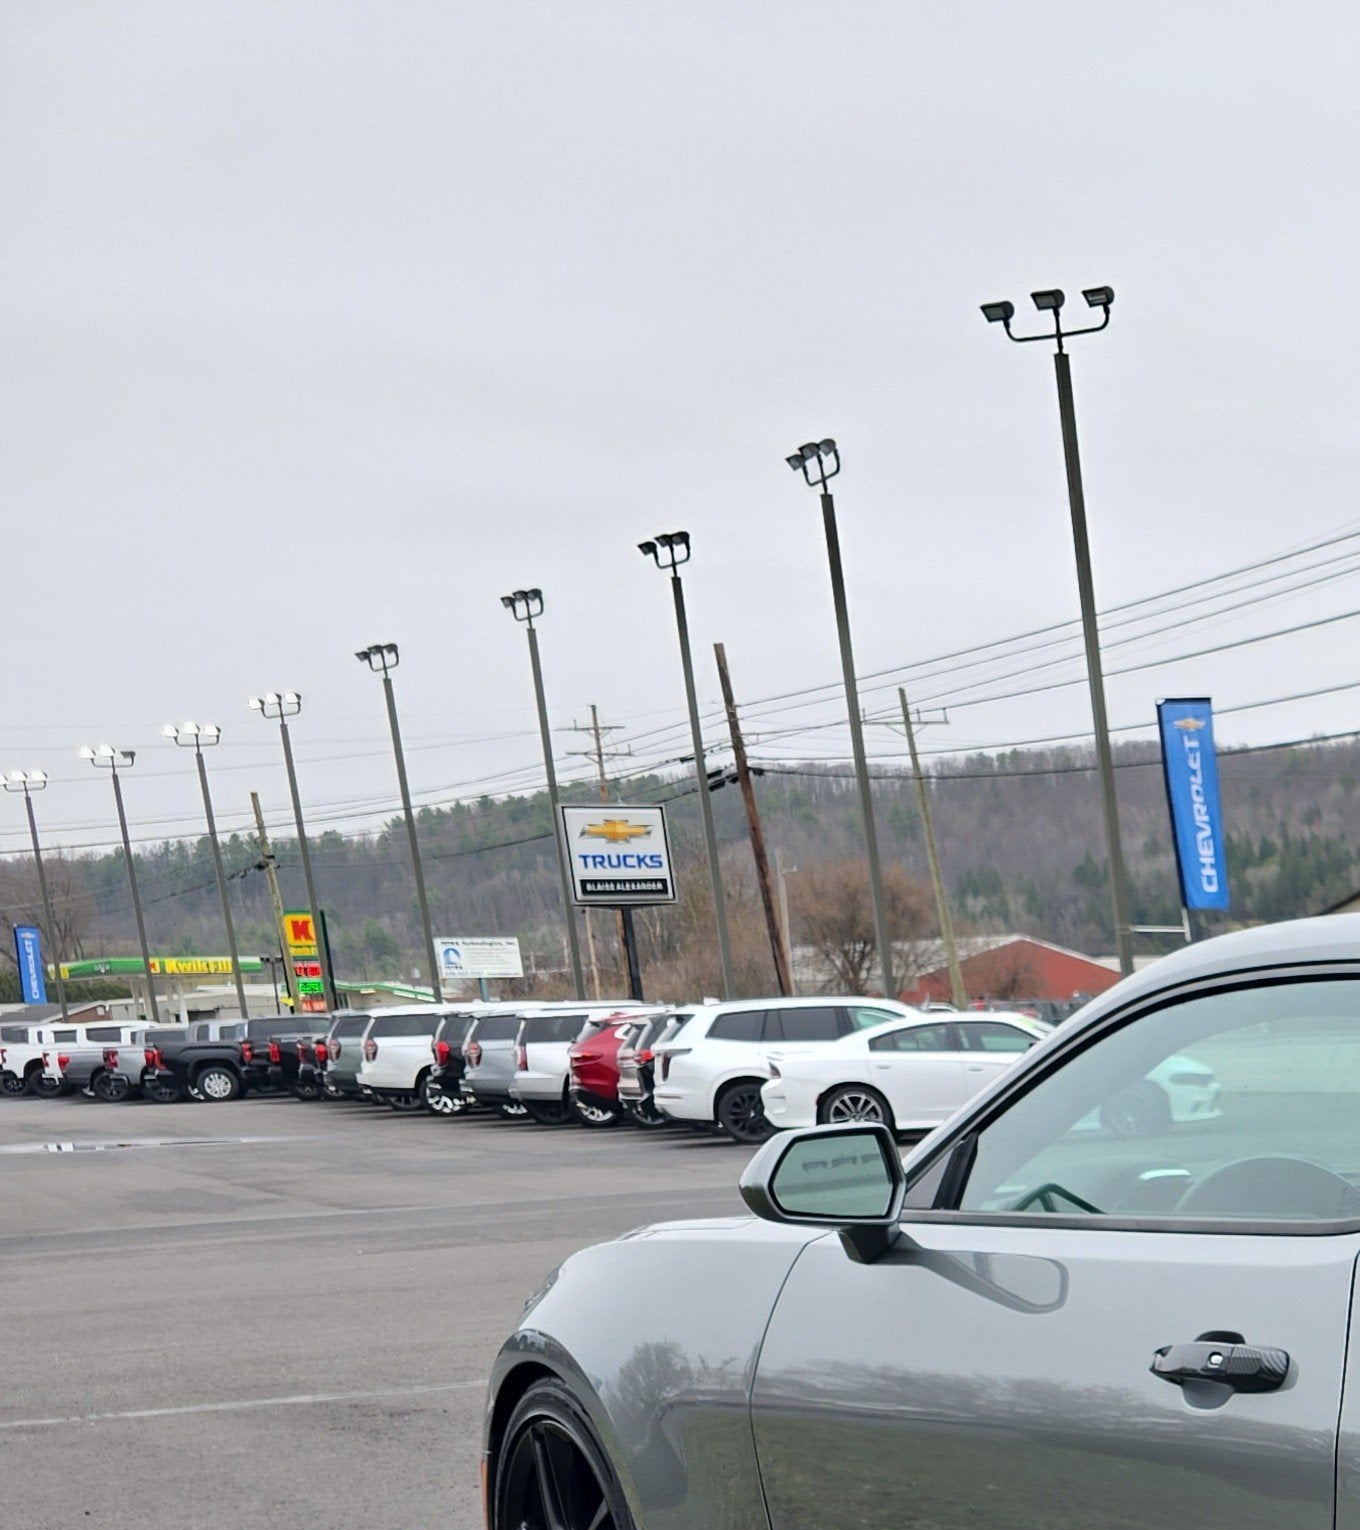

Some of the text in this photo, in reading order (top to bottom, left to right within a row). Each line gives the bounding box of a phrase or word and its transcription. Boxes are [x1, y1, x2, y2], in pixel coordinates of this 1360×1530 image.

[1183, 736, 1220, 893] CHEVROLET
[578, 854, 664, 869] TRUCKS
[616, 881, 664, 891] ALEXANDER
[290, 920, 314, 942] K
[165, 958, 209, 974] Kwik
